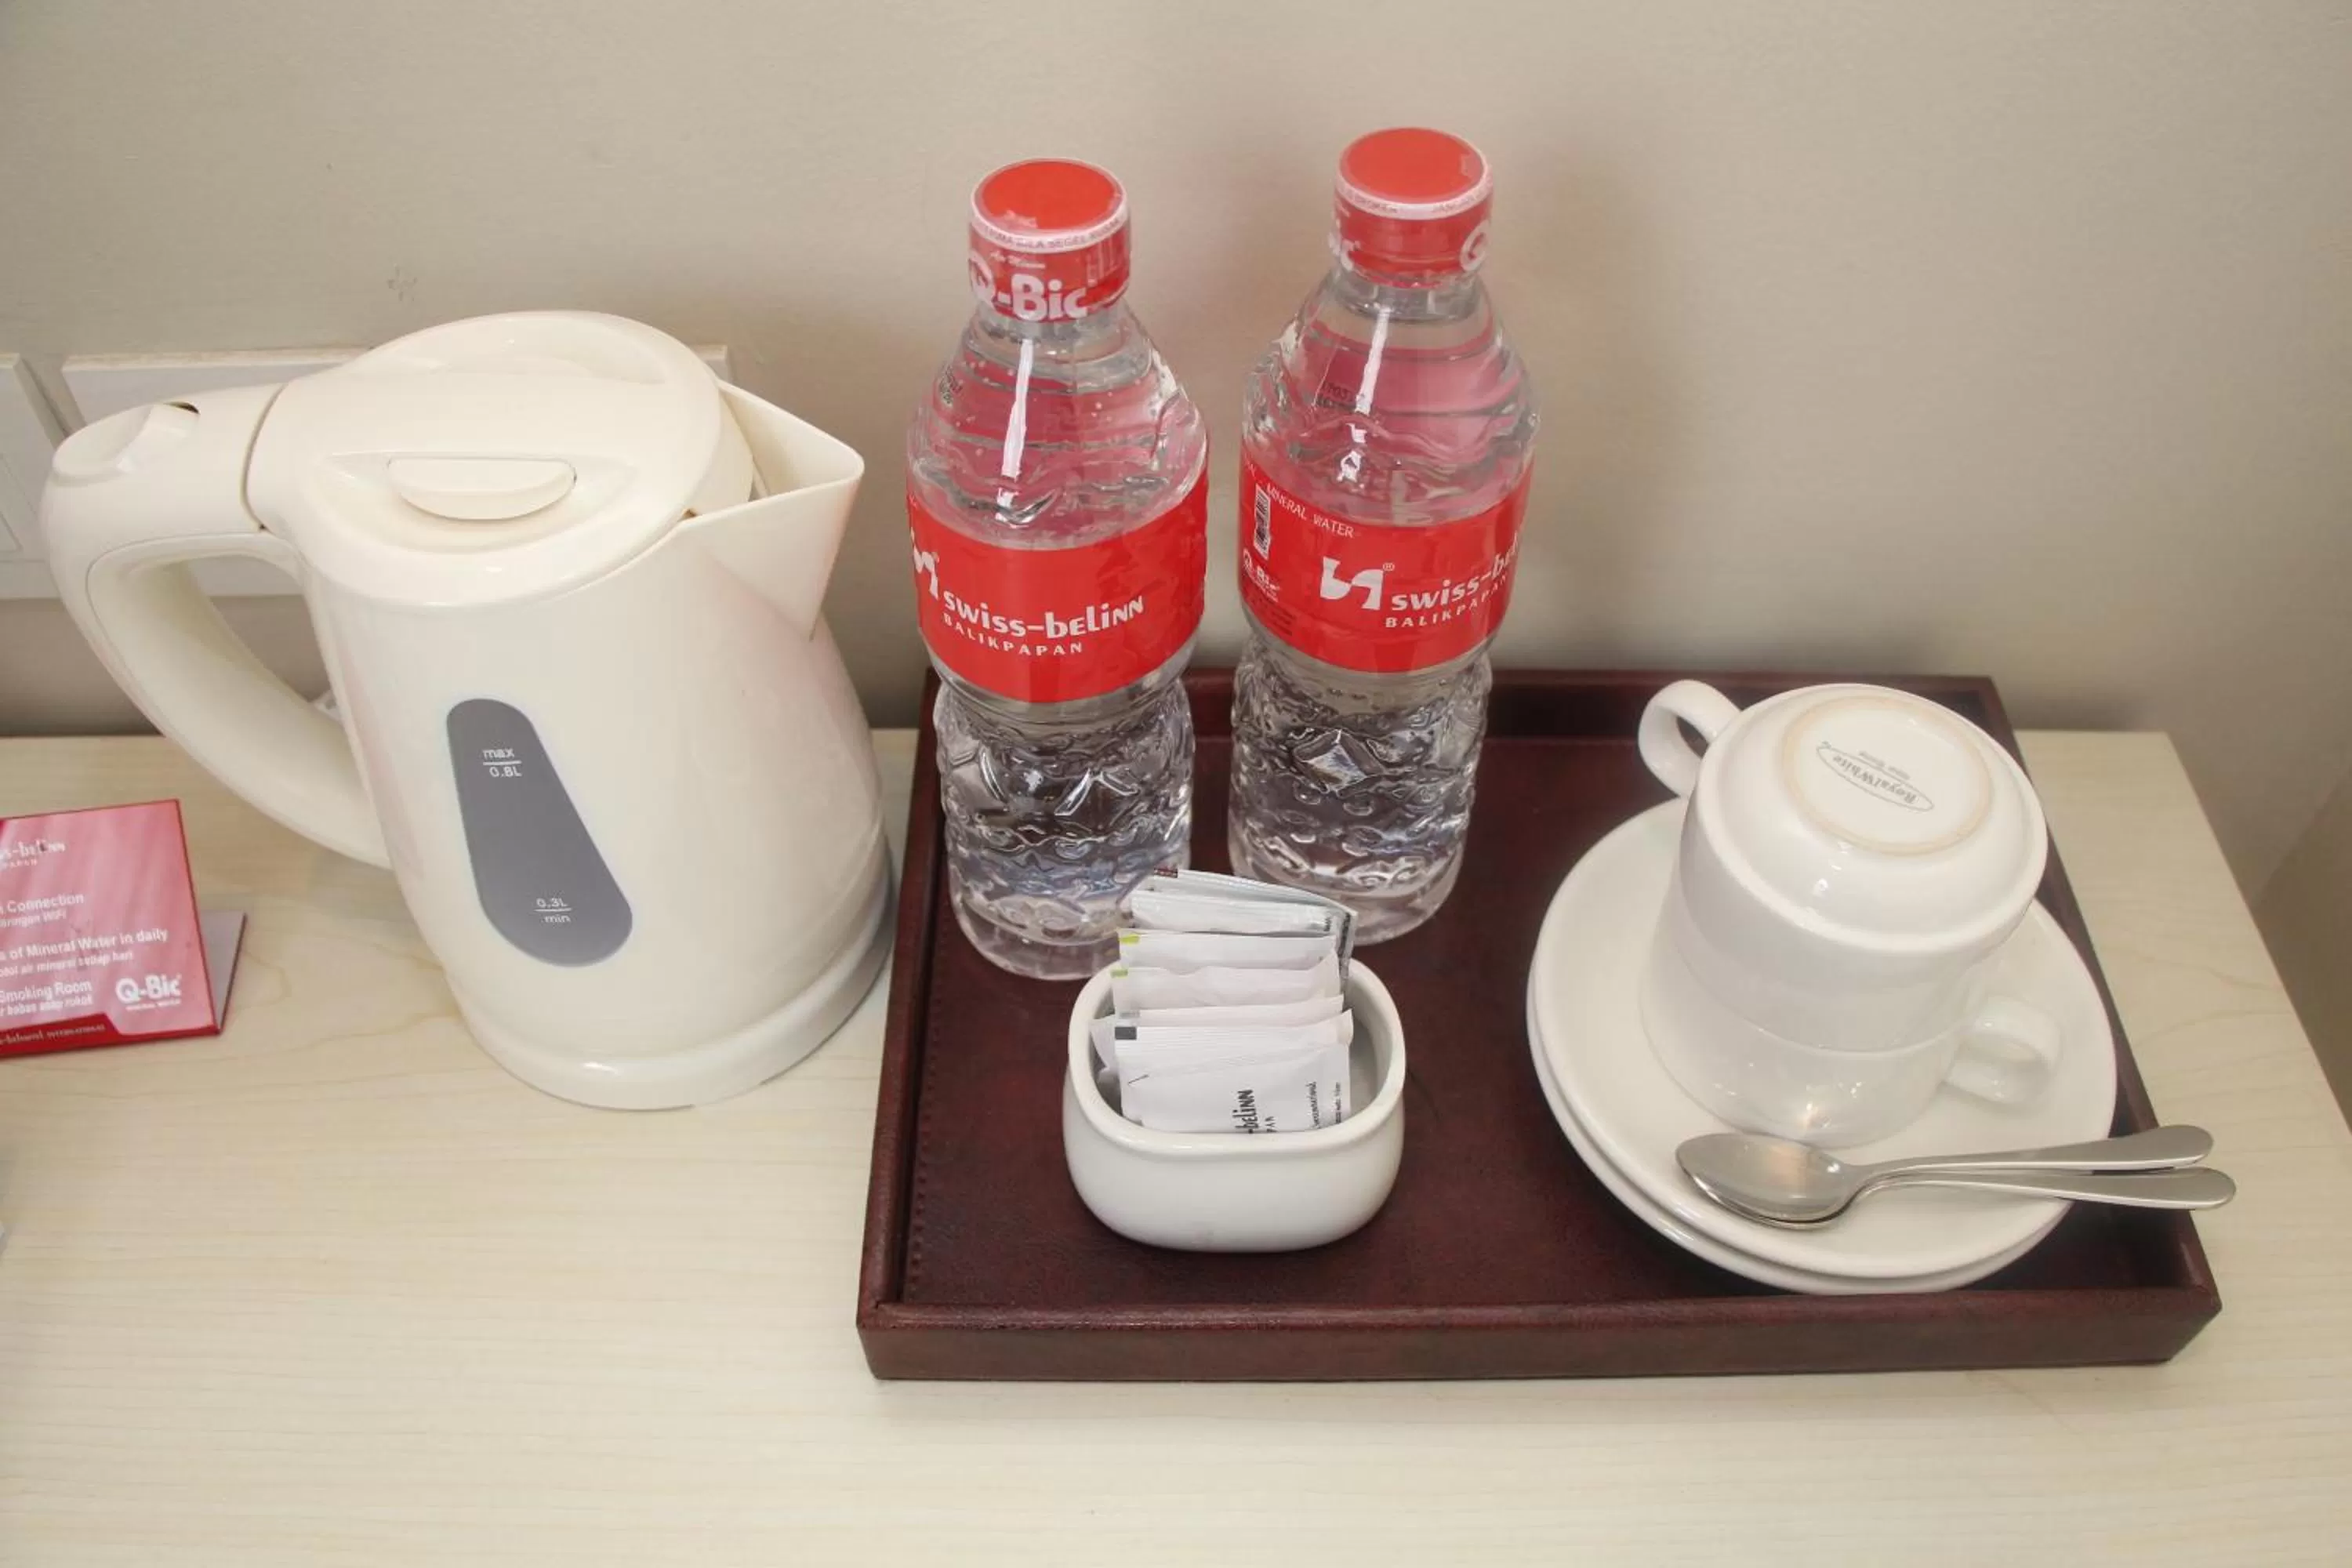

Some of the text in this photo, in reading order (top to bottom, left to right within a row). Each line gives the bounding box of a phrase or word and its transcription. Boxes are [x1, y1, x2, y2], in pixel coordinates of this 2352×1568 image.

[1266, 482, 1355, 539] MINERAL WATER
[943, 612, 1083, 656] BALIKPAPAN
[482, 748, 514, 760] max
[489, 765, 522, 778] 0.8L
[7, 894, 84, 913] Connection
[536, 897, 567, 908] 0.3L
[544, 914, 571, 924] min
[11, 946, 23, 960] of
[27, 939, 76, 956] Mineral
[78, 935, 115, 950] Water
[120, 932, 132, 945] in
[136, 928, 169, 944] daily
[54, 980, 93, 995] Room
[115, 974, 182, 1004] Q-Bic
